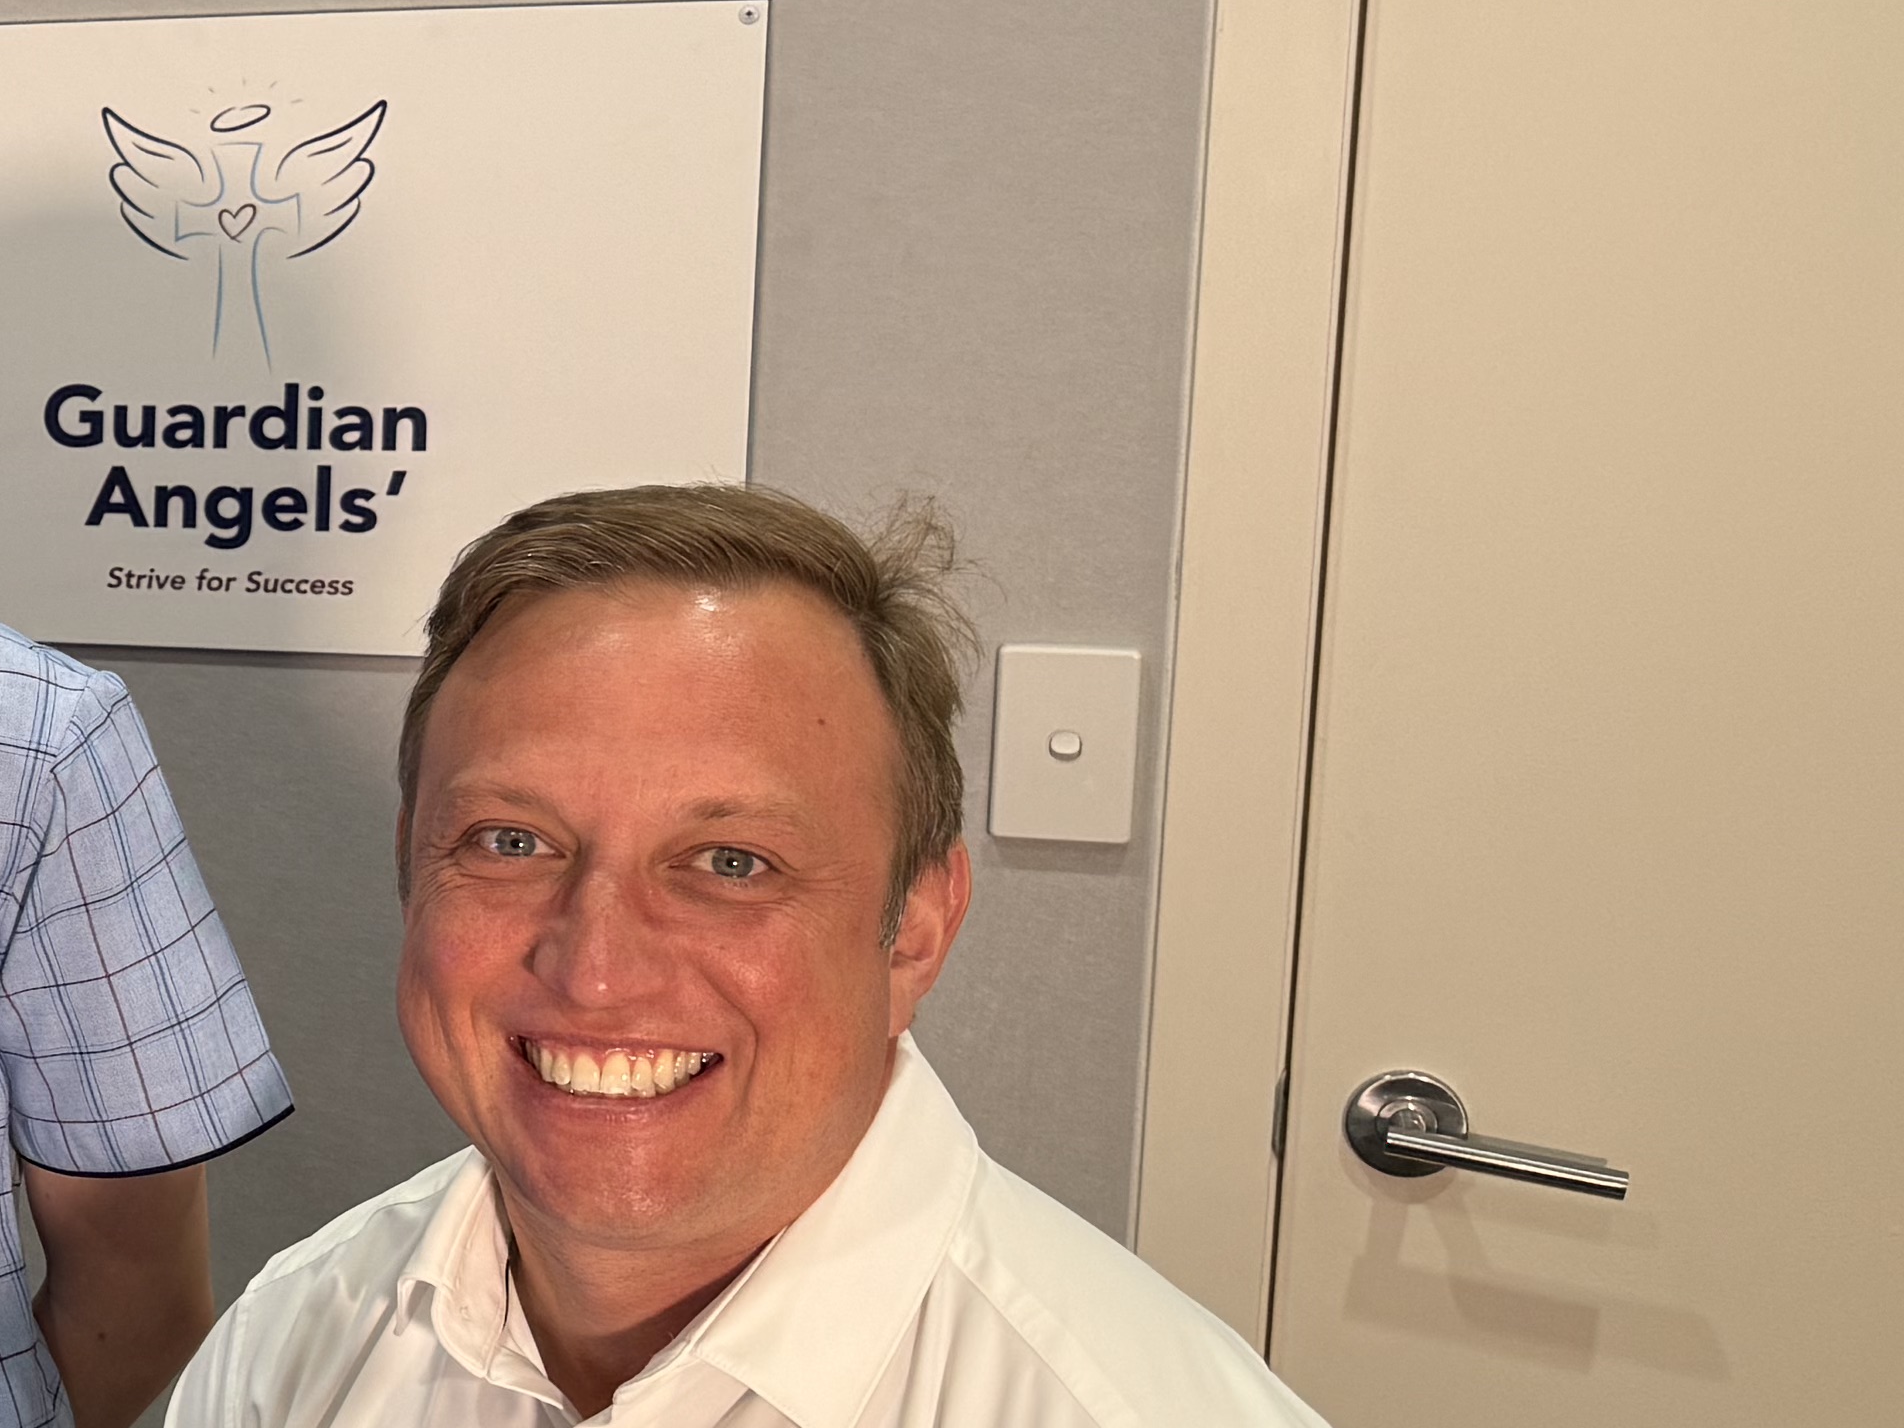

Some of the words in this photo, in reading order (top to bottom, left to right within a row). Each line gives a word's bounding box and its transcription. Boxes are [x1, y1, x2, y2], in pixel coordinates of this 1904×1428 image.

[44, 383, 428, 453] Guardian
[106, 565, 187, 592] Strive
[195, 567, 239, 593] for
[245, 570, 355, 597] Success
